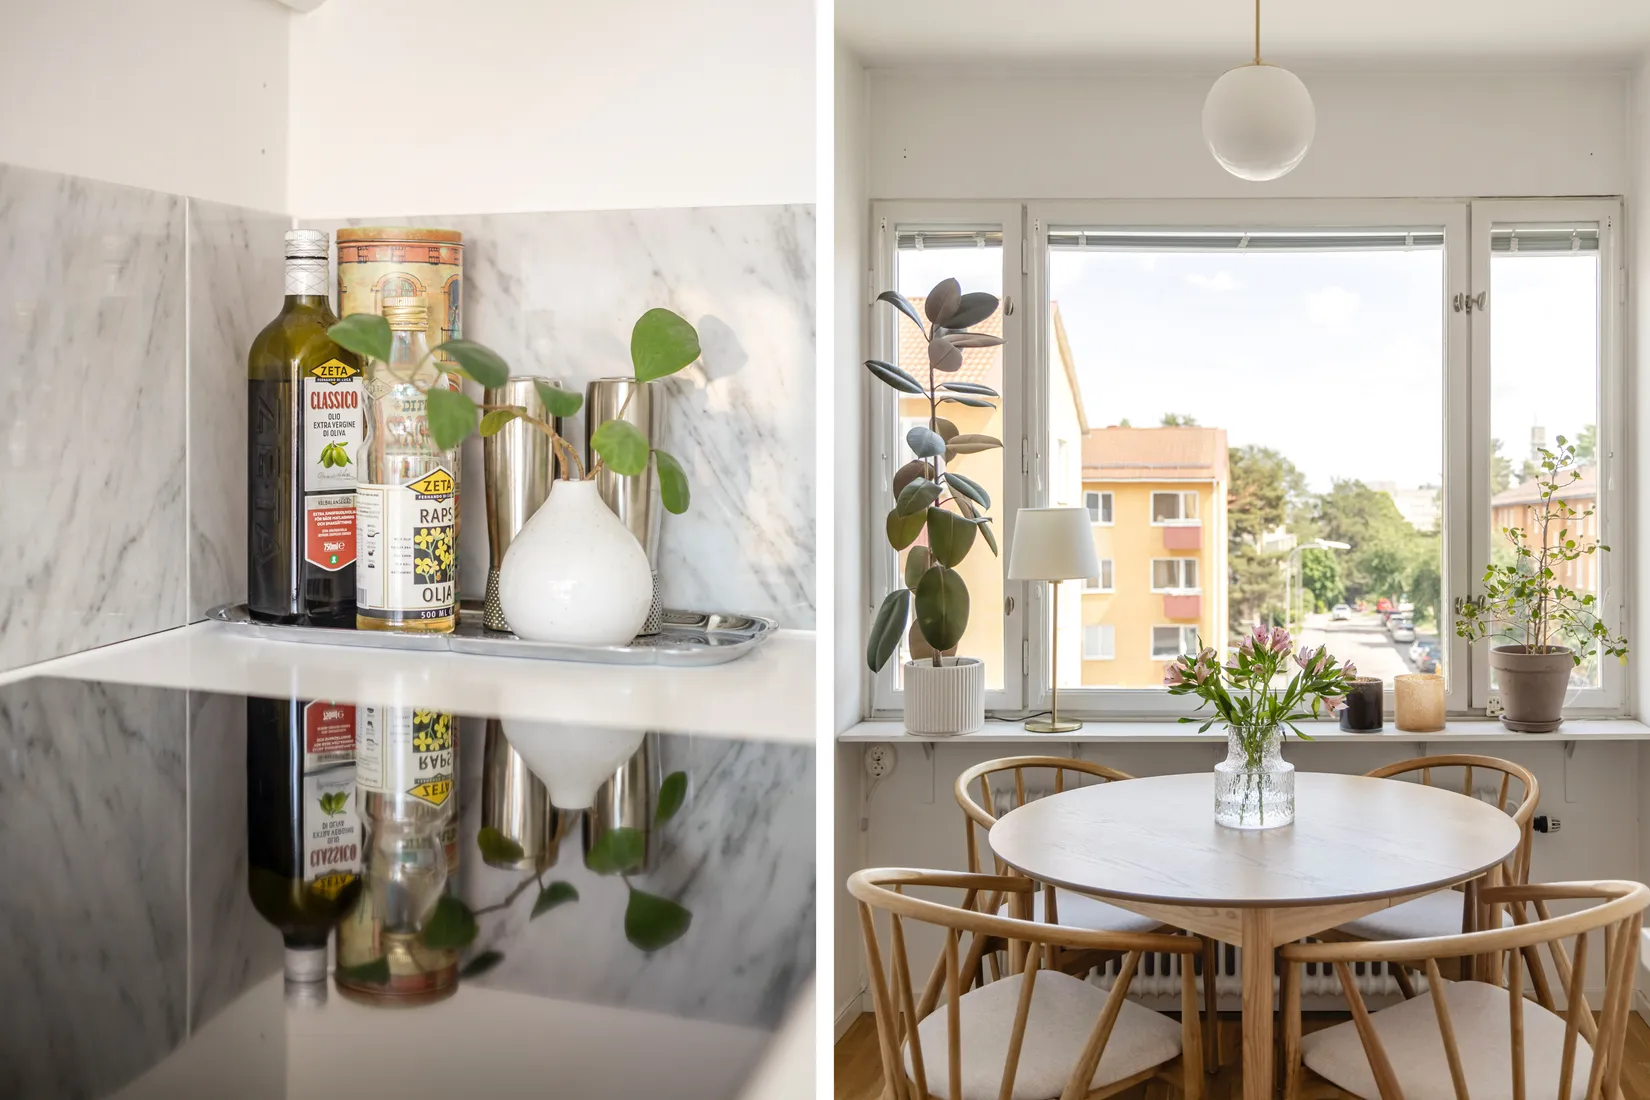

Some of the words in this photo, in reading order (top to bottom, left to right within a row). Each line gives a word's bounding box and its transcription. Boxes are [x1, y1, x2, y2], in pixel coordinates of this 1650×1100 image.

[321, 366, 348, 376] ZETA
[311, 391, 358, 410] CLASSICO
[424, 480, 451, 492] ZETA
[420, 507, 453, 523] RAPS
[423, 585, 452, 603] OLJA
